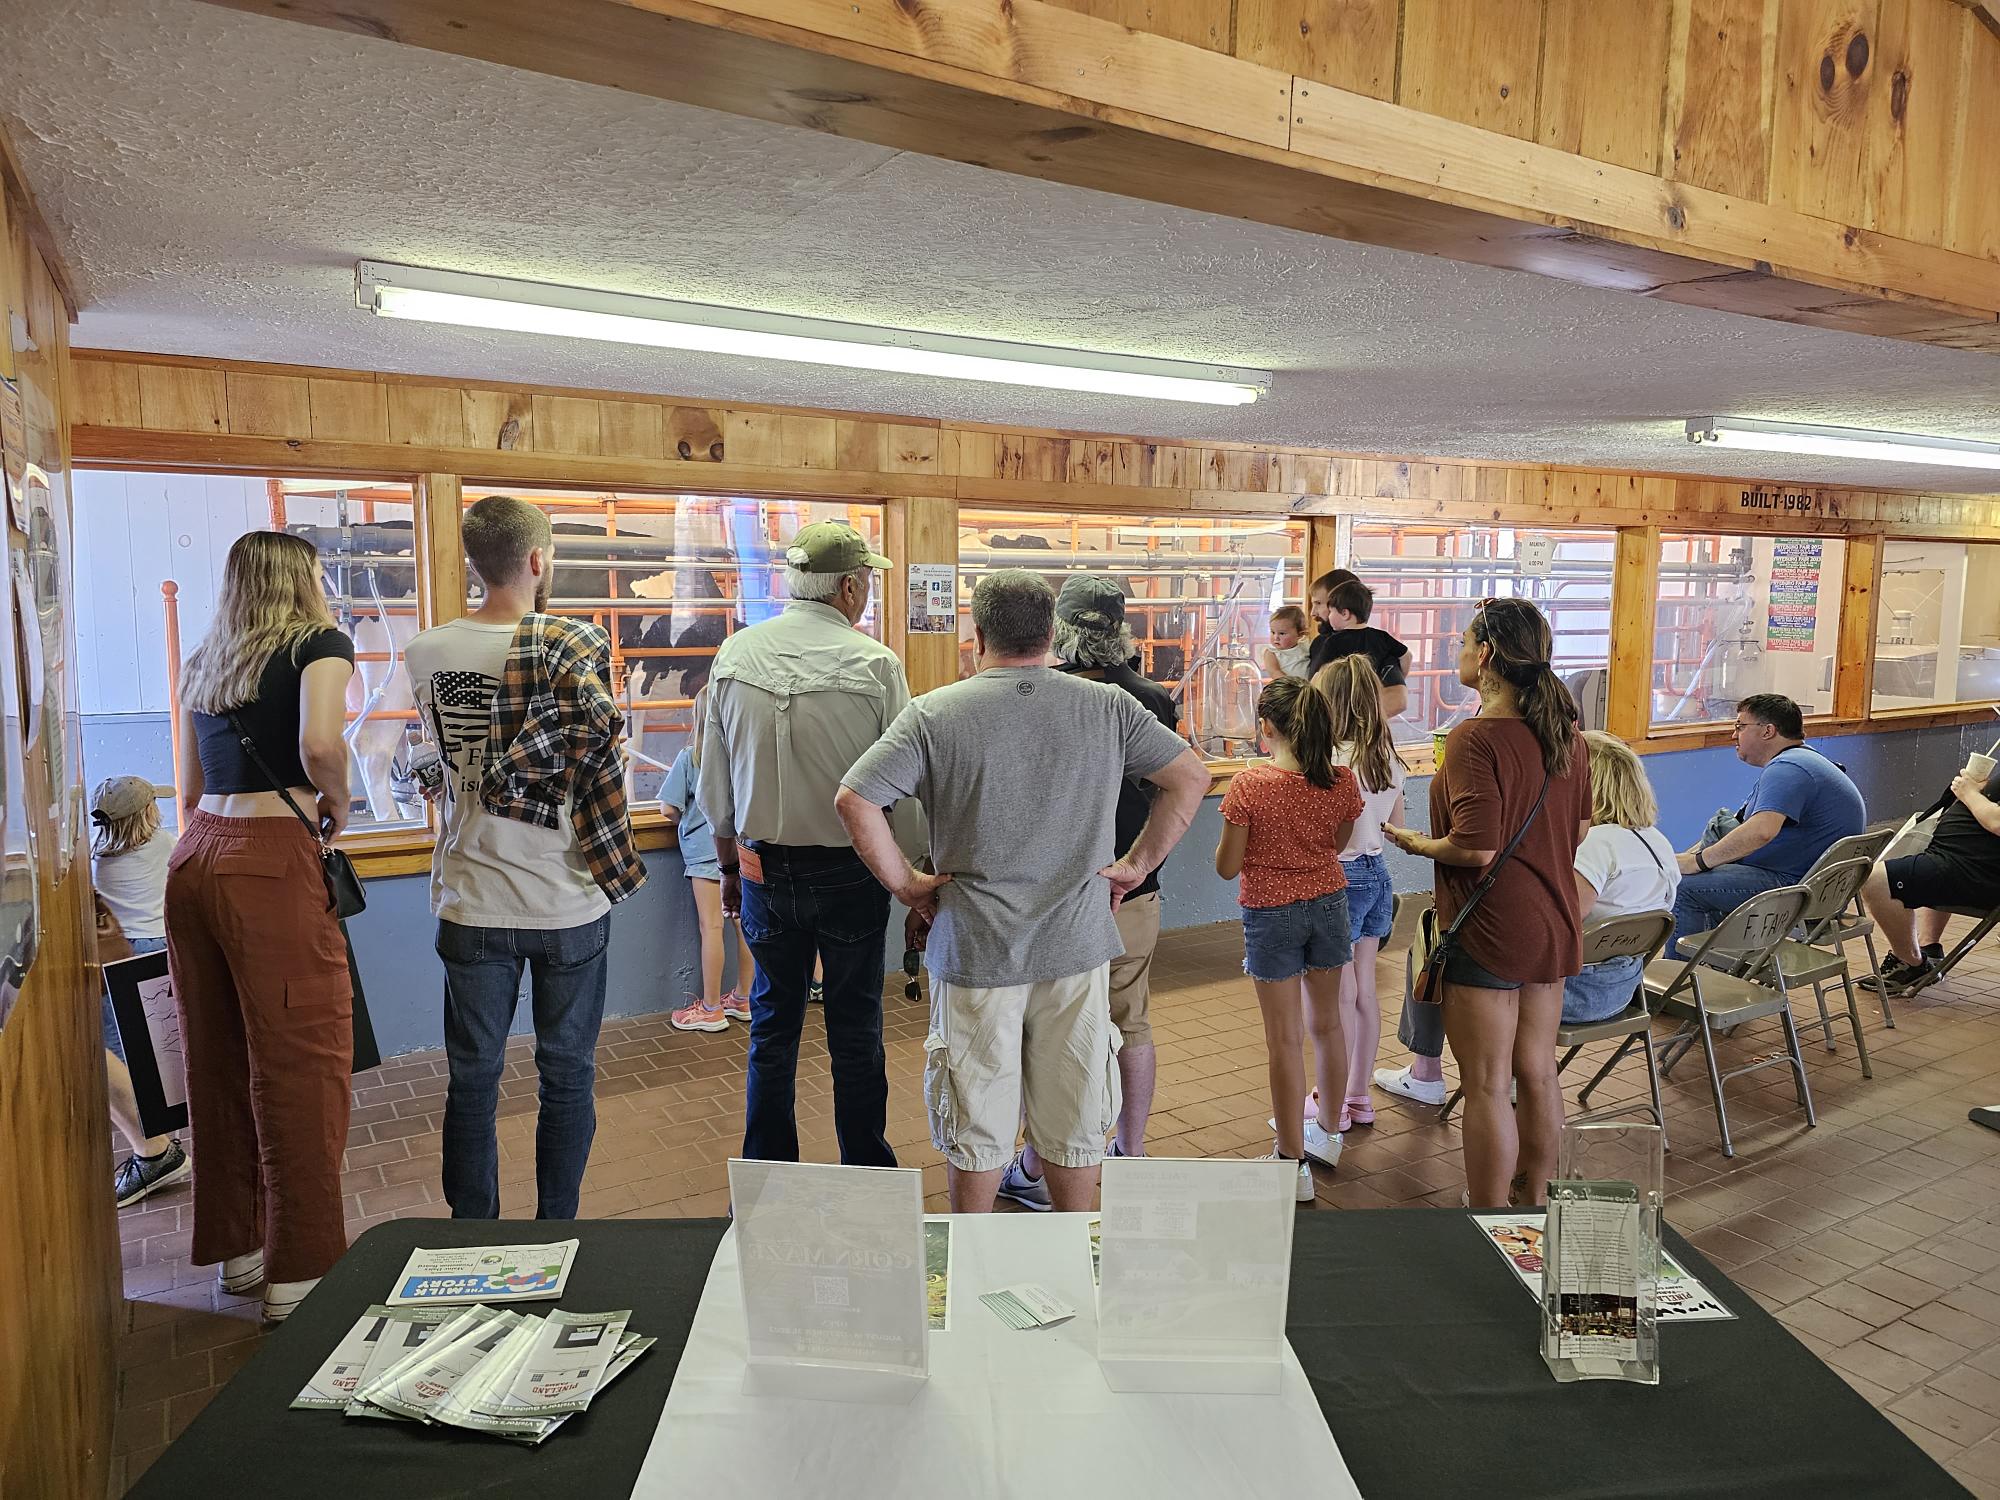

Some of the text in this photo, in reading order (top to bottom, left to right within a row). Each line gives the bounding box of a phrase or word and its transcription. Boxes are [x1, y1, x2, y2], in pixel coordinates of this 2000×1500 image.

[1741, 491, 1811, 510] BUILT 1982
[1610, 934, 1640, 948] FAIR
[417, 1279, 478, 1288] STORY
[414, 1287, 463, 1296] MILK
[532, 1383, 579, 1394] PINELAND
[541, 1401, 576, 1409] Visitor's
[473, 1417, 499, 1425] Guide
